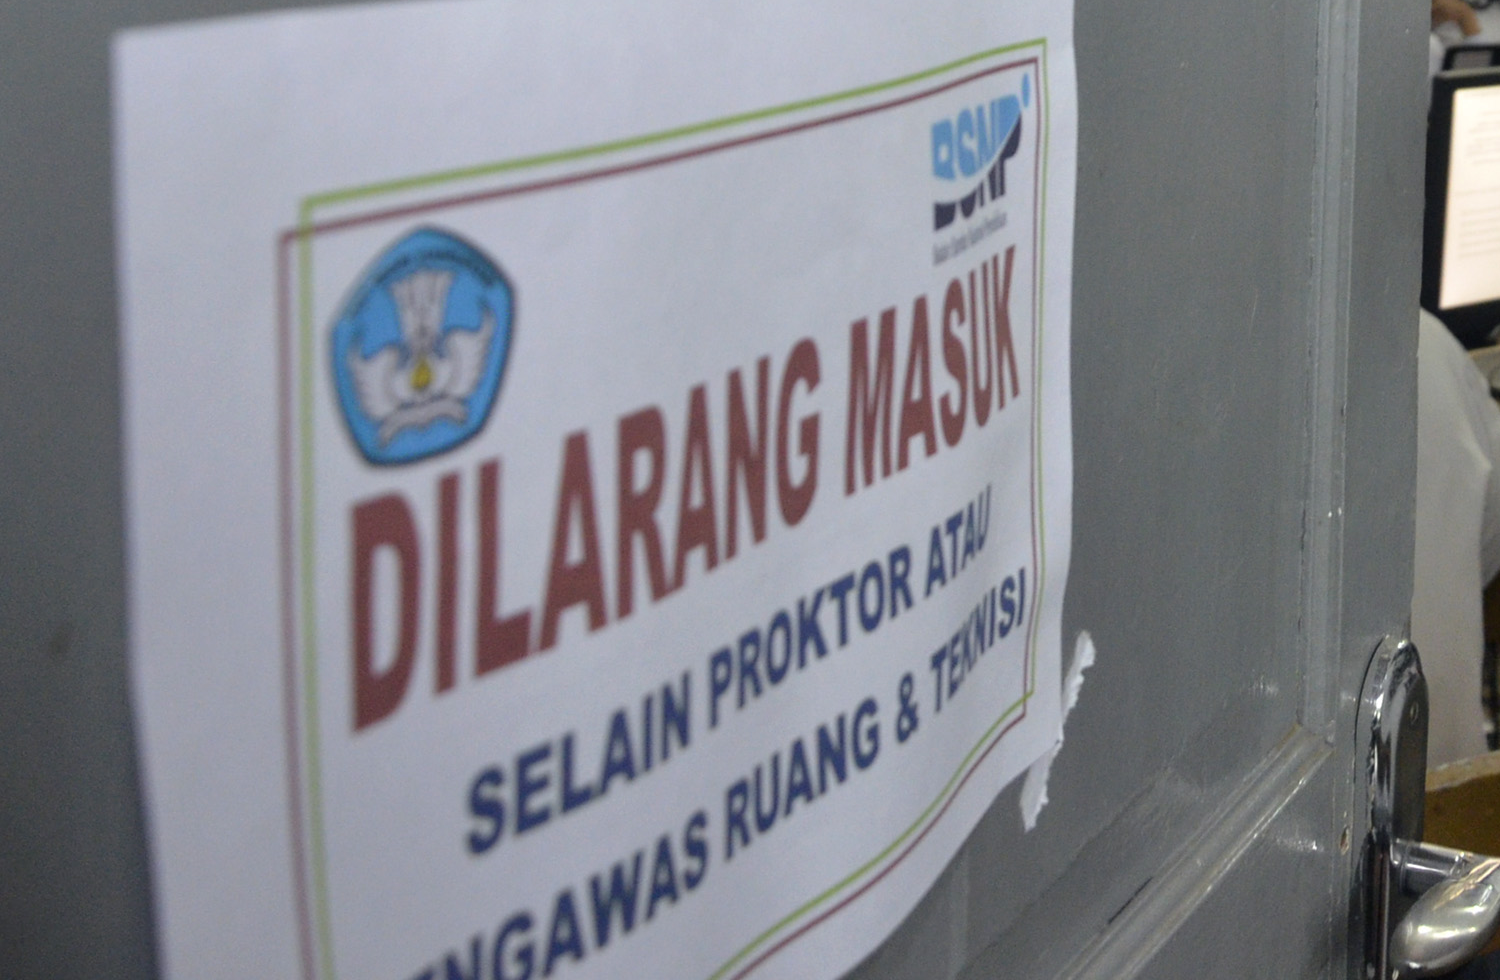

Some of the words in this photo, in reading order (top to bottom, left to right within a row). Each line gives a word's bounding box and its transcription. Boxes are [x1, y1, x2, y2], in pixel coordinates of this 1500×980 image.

[347, 338, 822, 738] DILARANG
[844, 246, 1020, 498] MASUK
[463, 671, 692, 860] SELAIN
[708, 544, 915, 731] PROKTOR
[924, 484, 990, 598] ATAU
[723, 696, 880, 864] RUANG
[894, 672, 920, 745] &
[930, 568, 1027, 715] TEKNISI
